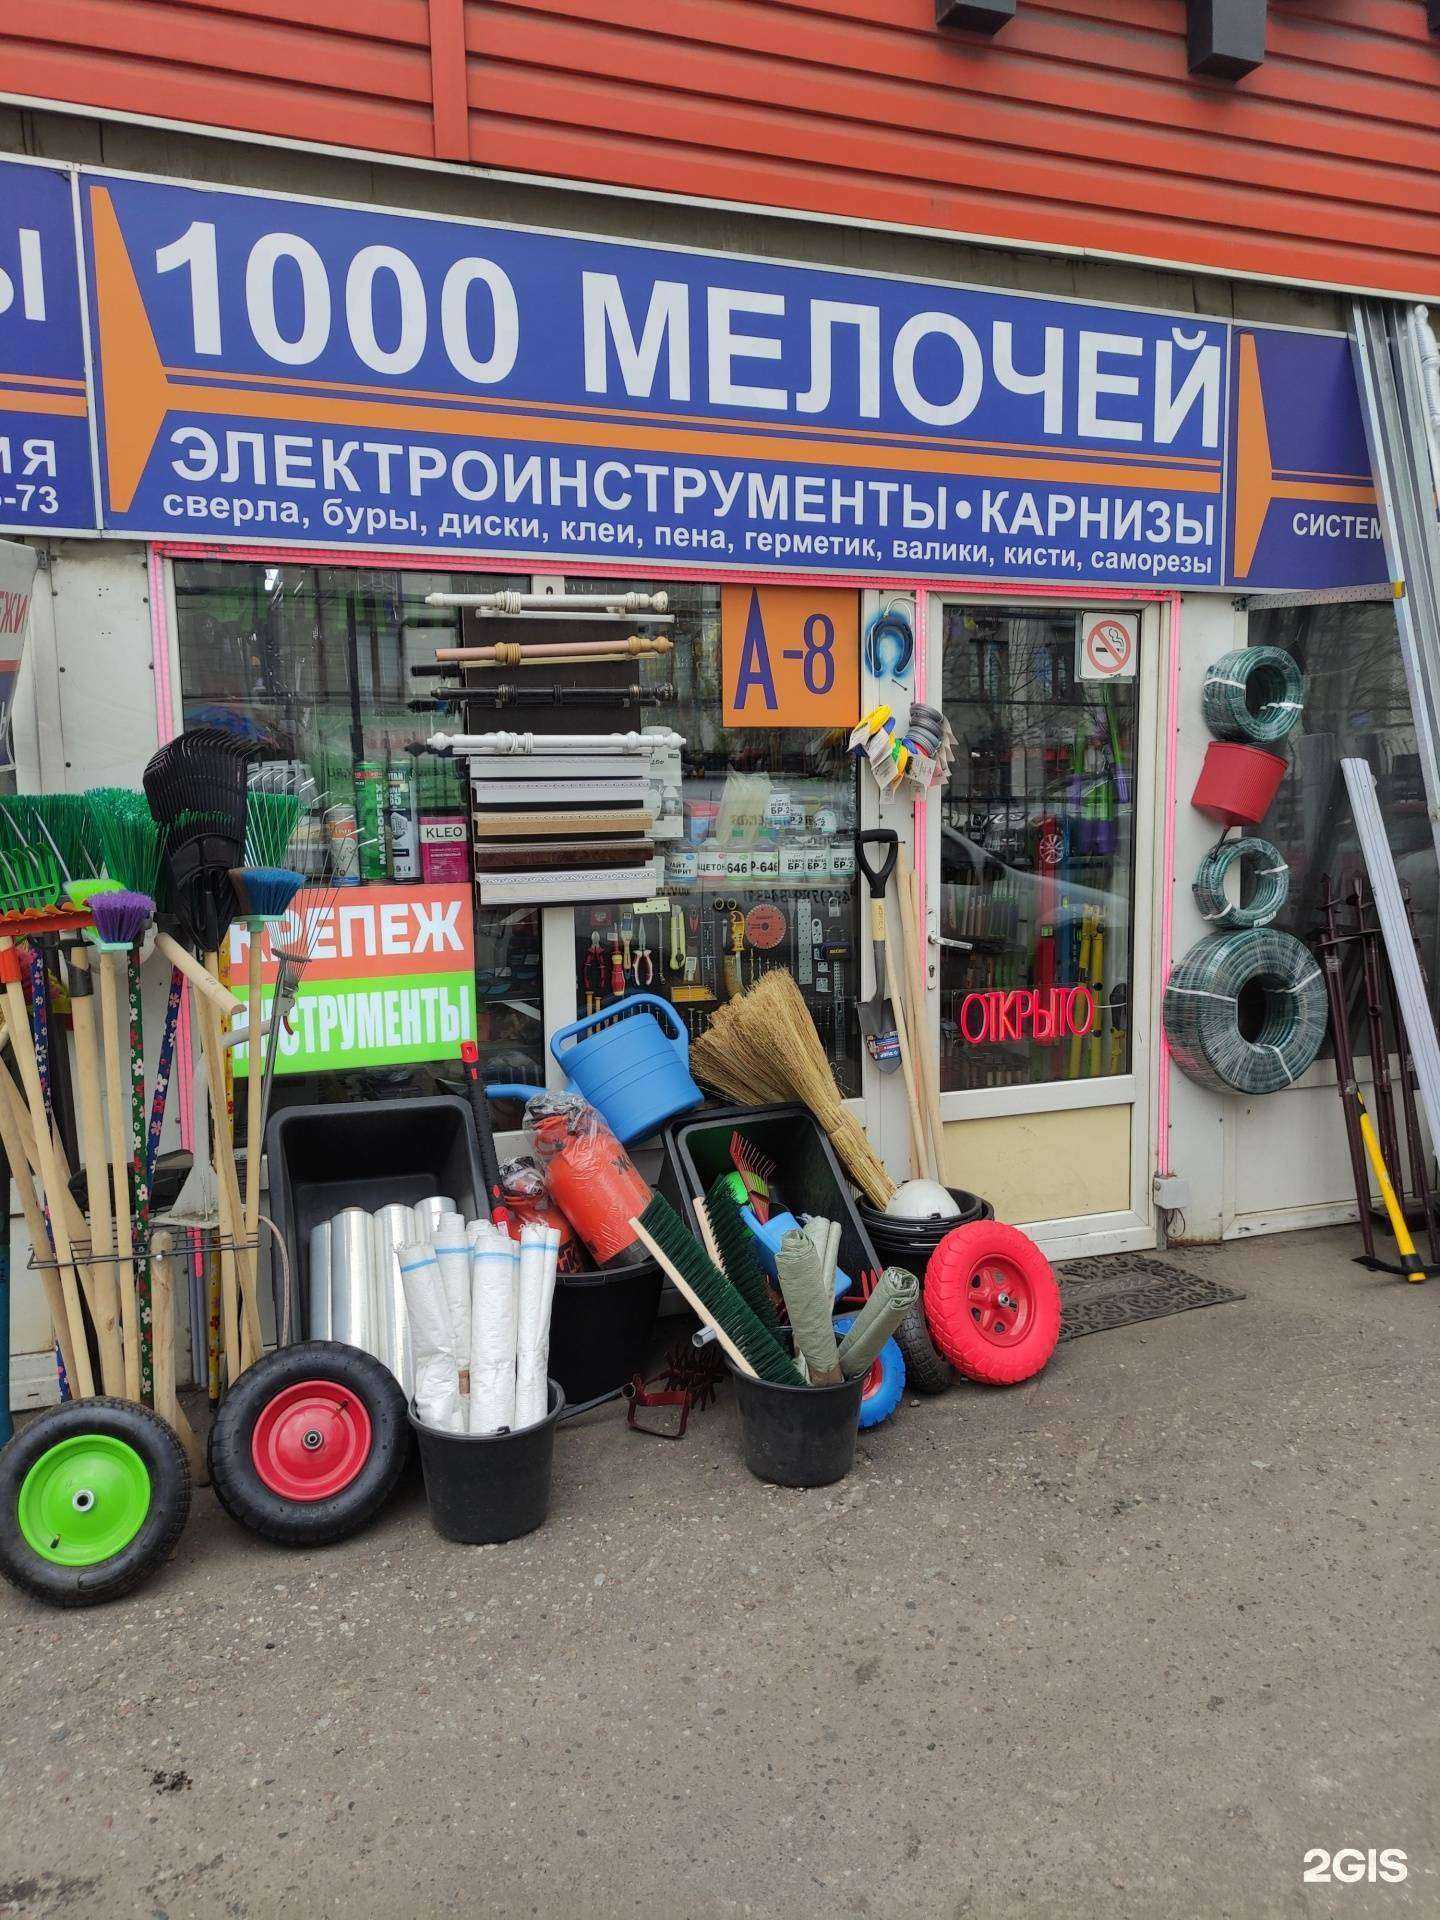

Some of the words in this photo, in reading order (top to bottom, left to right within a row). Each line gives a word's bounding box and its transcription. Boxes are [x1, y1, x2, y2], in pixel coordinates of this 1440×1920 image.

[155, 220, 520, 384] 1000
[581, 270, 1221, 448] МЕЛОЧЕЙ
[0, 484, 59, 514] -73
[169, 426, 947, 531] ЭЛЕКТРОИНСТРУМЕНТЫ
[981, 489, 1214, 546] КАРНИЗЫ
[162, 492, 310, 530] сверла,
[322, 497, 428, 536] буры,
[438, 509, 549, 543] диски,
[560, 519, 644, 549] клеи,
[655, 526, 735, 554] пена,
[745, 529, 882, 562] герметик,
[892, 539, 995, 568] валики,
[1003, 545, 1083, 572] кисти,
[1091, 550, 1213, 577] саморезы
[375, 783, 388, 865] MAKROFLEX
[426, 826, 463, 839] KLEO
[789, 816, 804, 825] Р-2
[727, 862, 748, 874] 646
[960, 985, 1095, 1045] ОТКРЫТО
